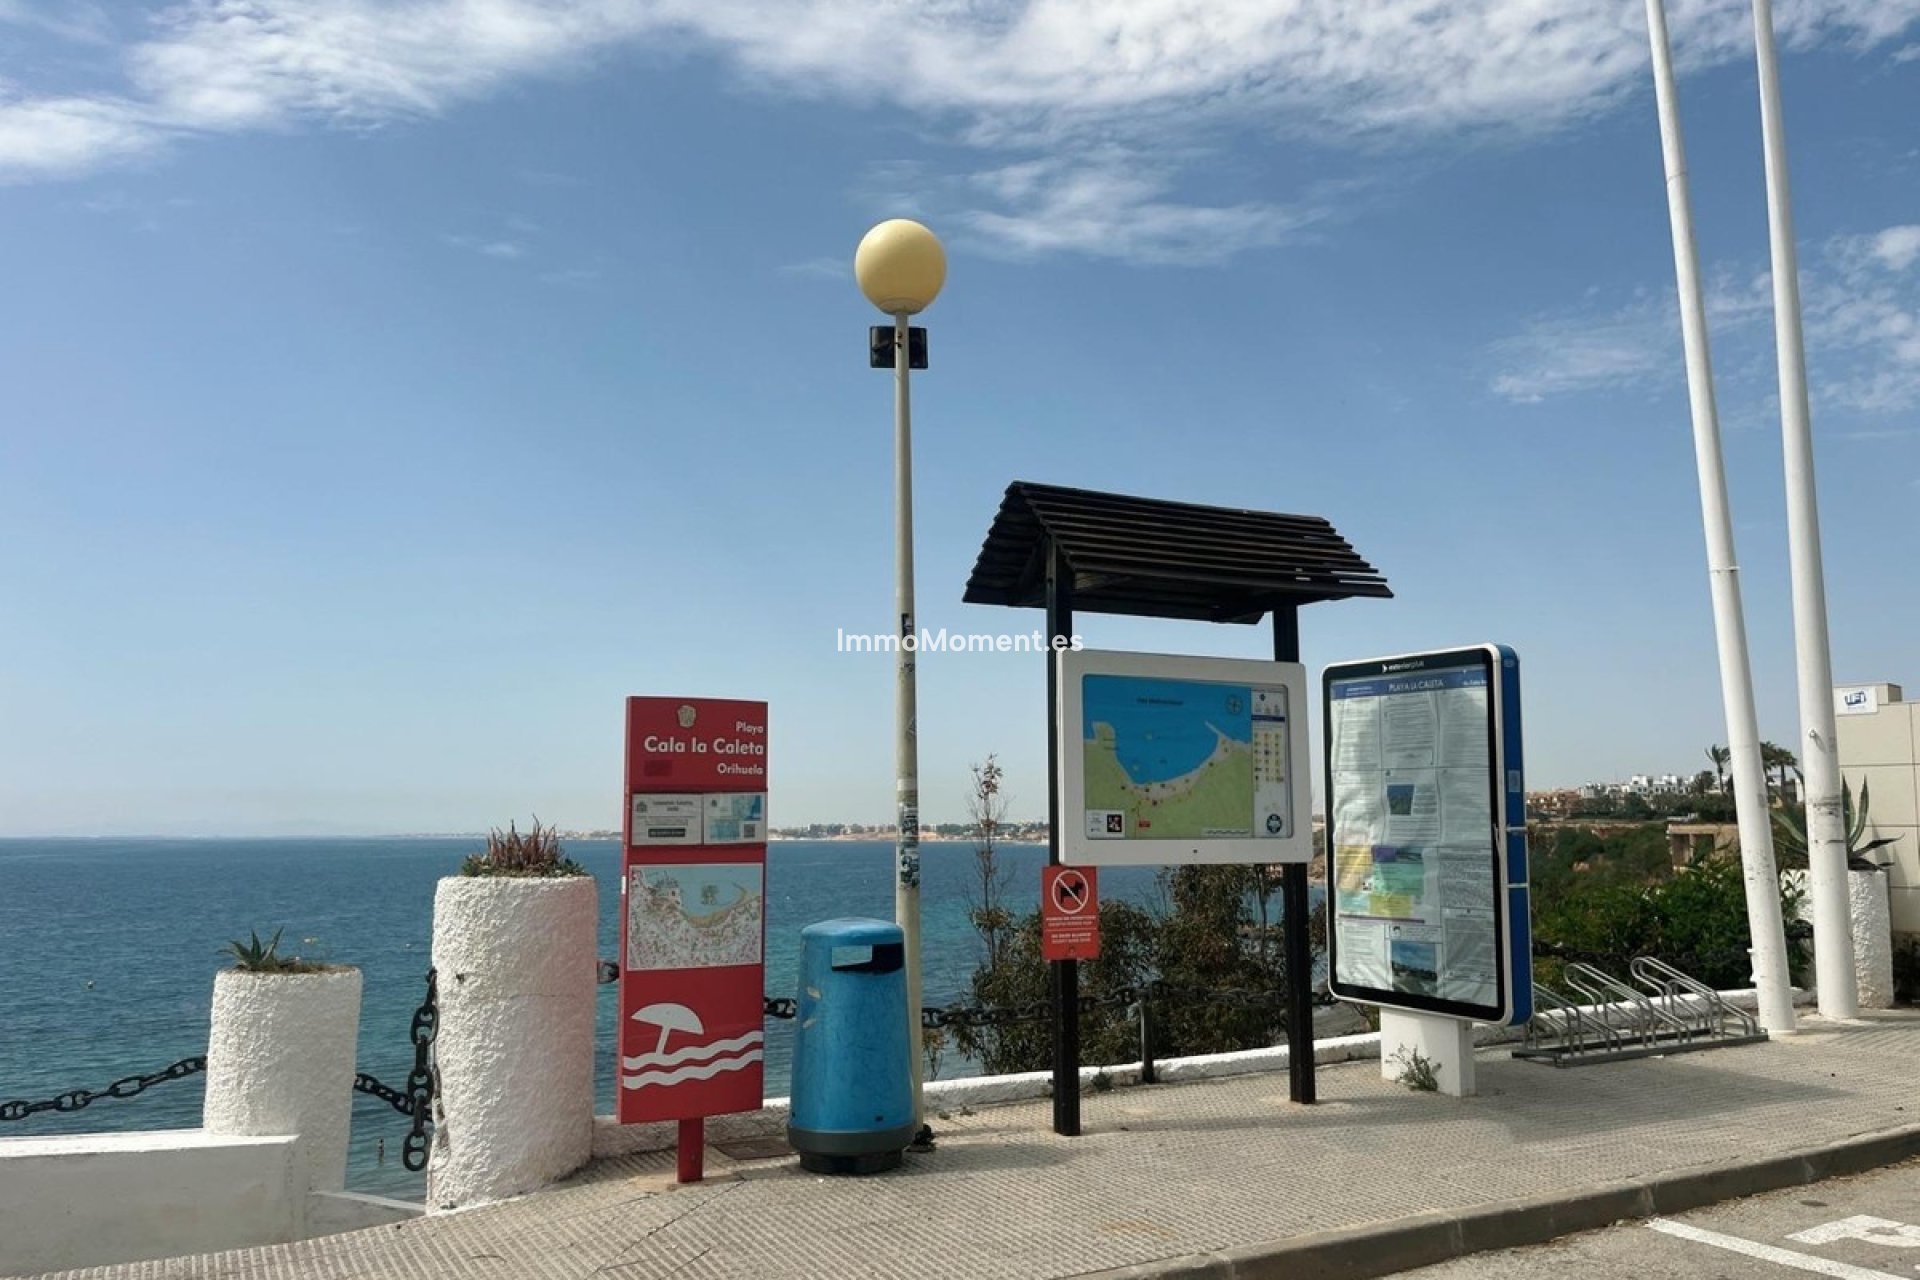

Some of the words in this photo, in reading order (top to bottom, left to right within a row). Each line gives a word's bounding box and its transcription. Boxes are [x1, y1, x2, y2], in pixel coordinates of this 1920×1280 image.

[735, 720, 764, 735] Playa
[644, 735, 686, 753] Cala
[691, 736, 708, 753] la
[713, 737, 764, 756] Caleta
[717, 762, 764, 775] Orihuela
